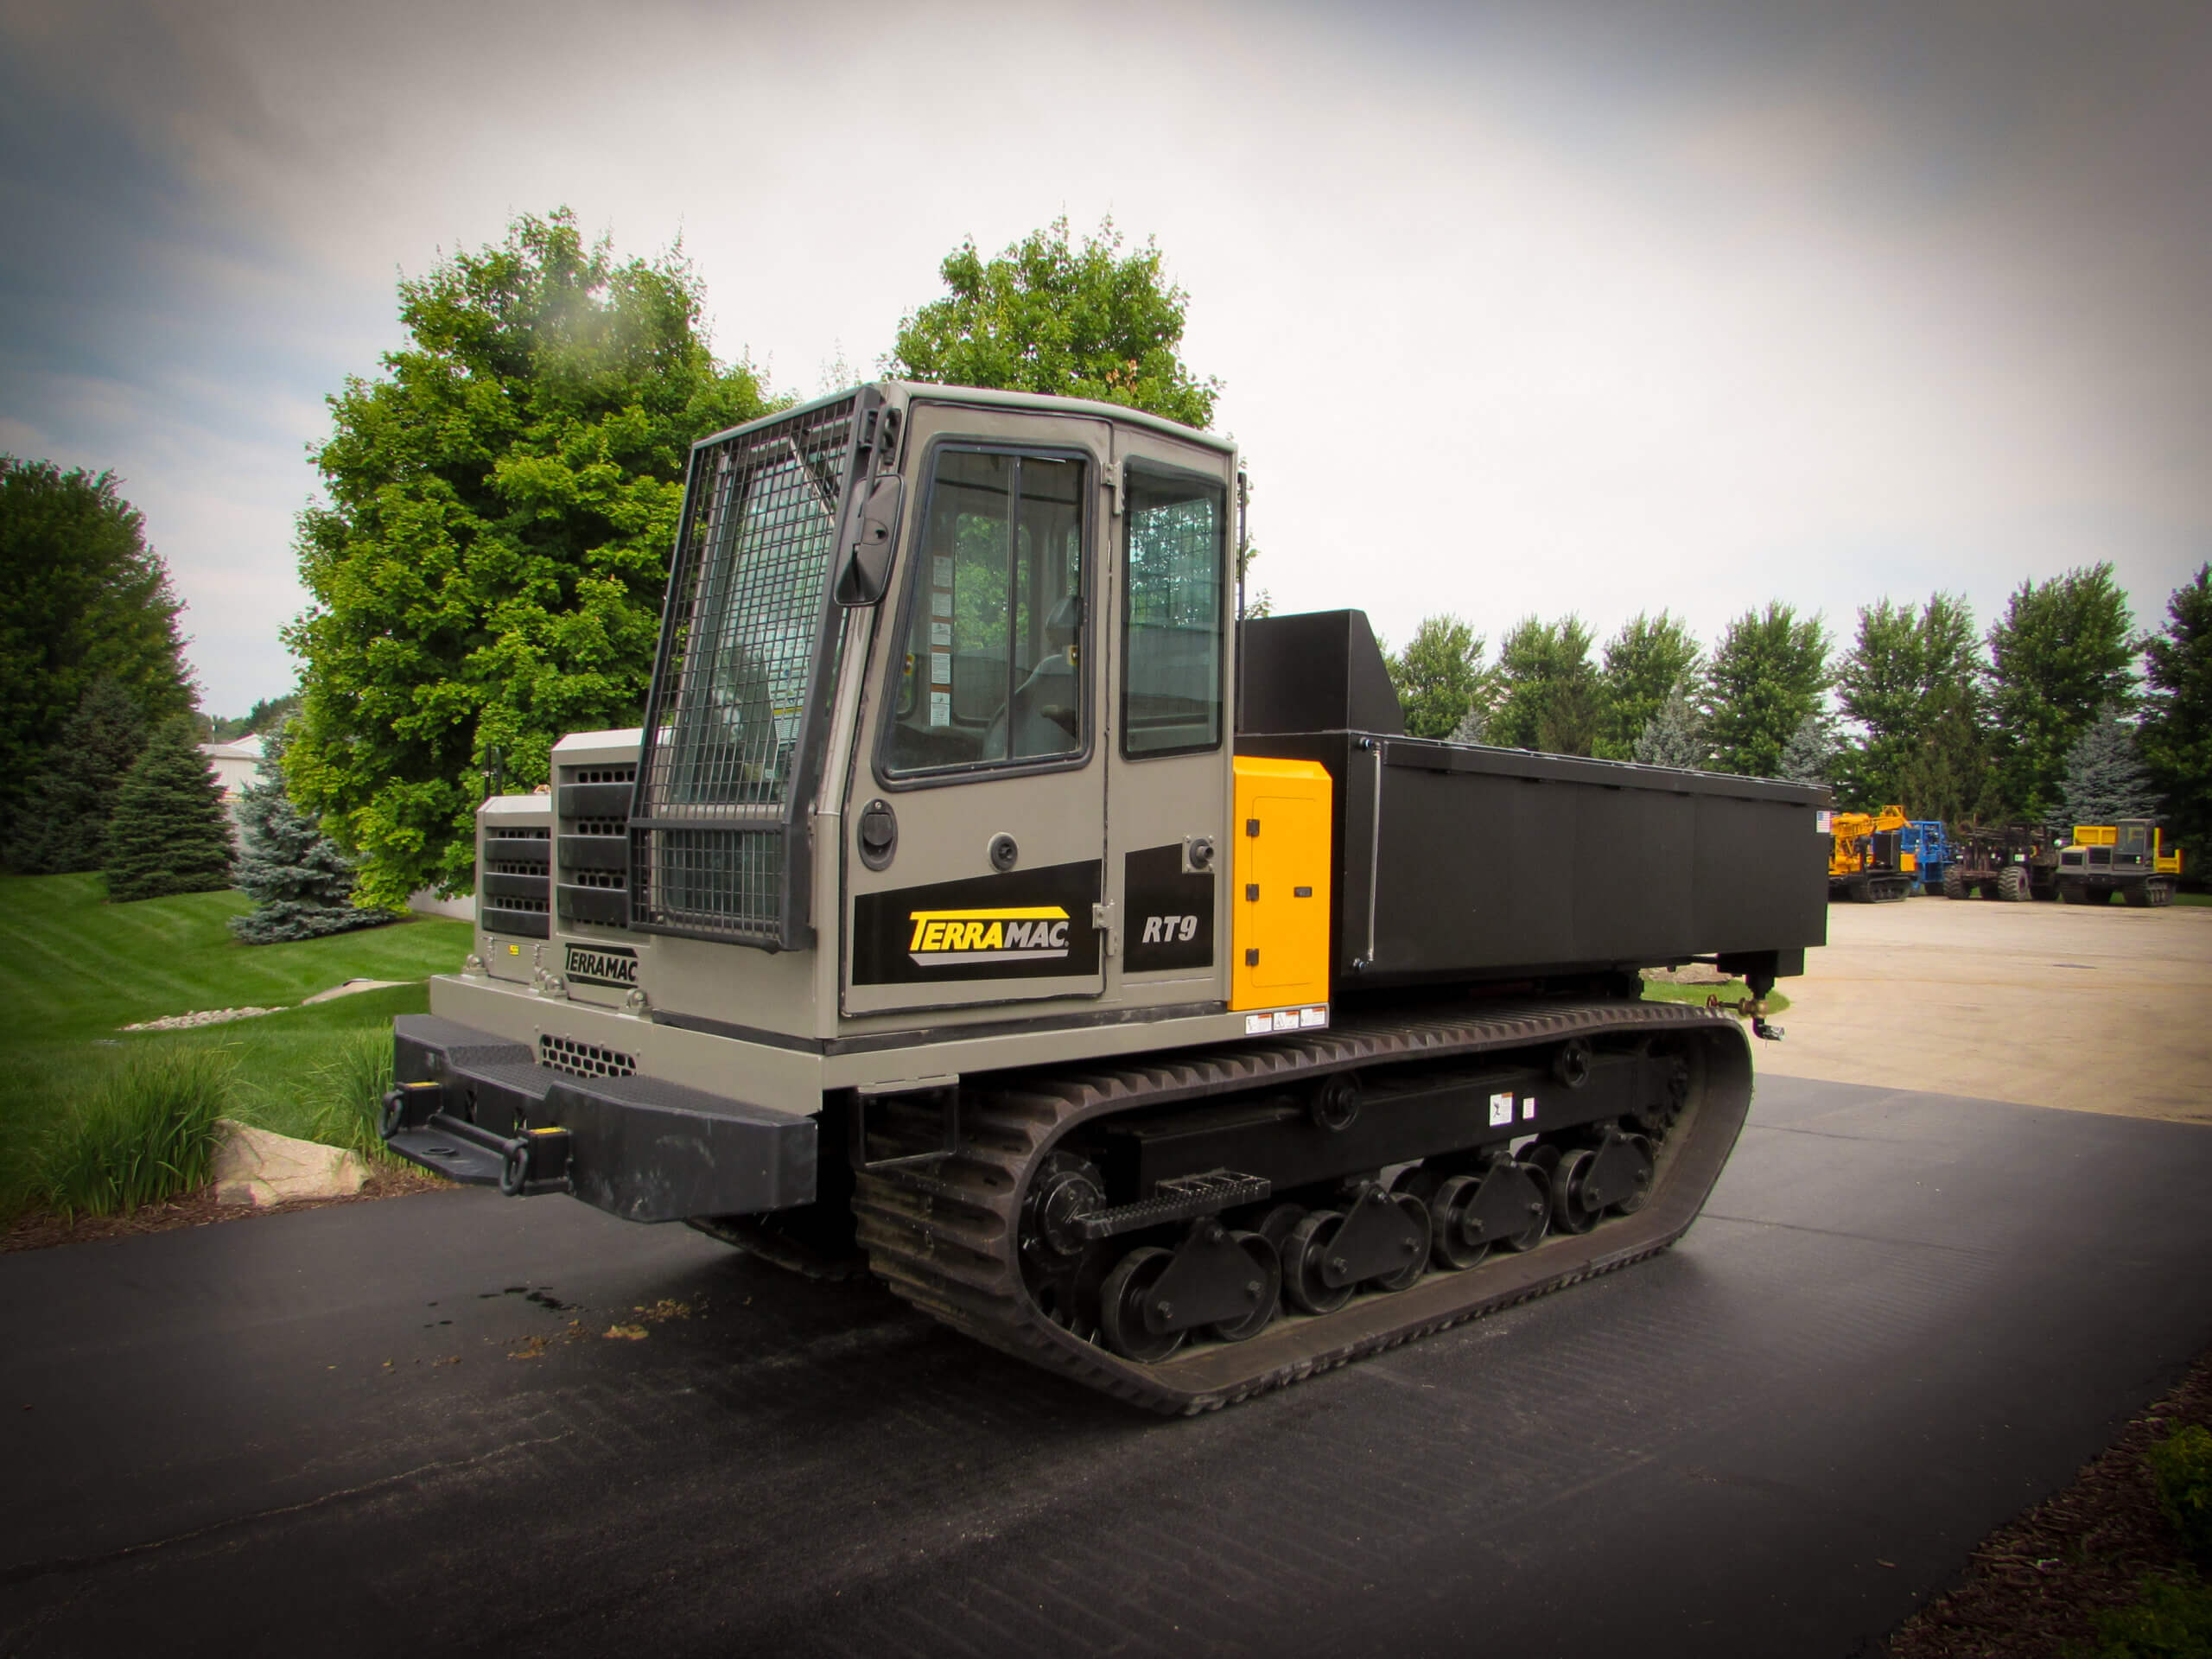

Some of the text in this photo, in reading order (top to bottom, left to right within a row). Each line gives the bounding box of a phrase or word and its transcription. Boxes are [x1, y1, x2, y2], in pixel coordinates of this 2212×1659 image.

[910, 906, 1070, 951] TERRAMAC
[1142, 915, 1198, 944] RT9
[565, 943, 638, 982] TERRAMAC
